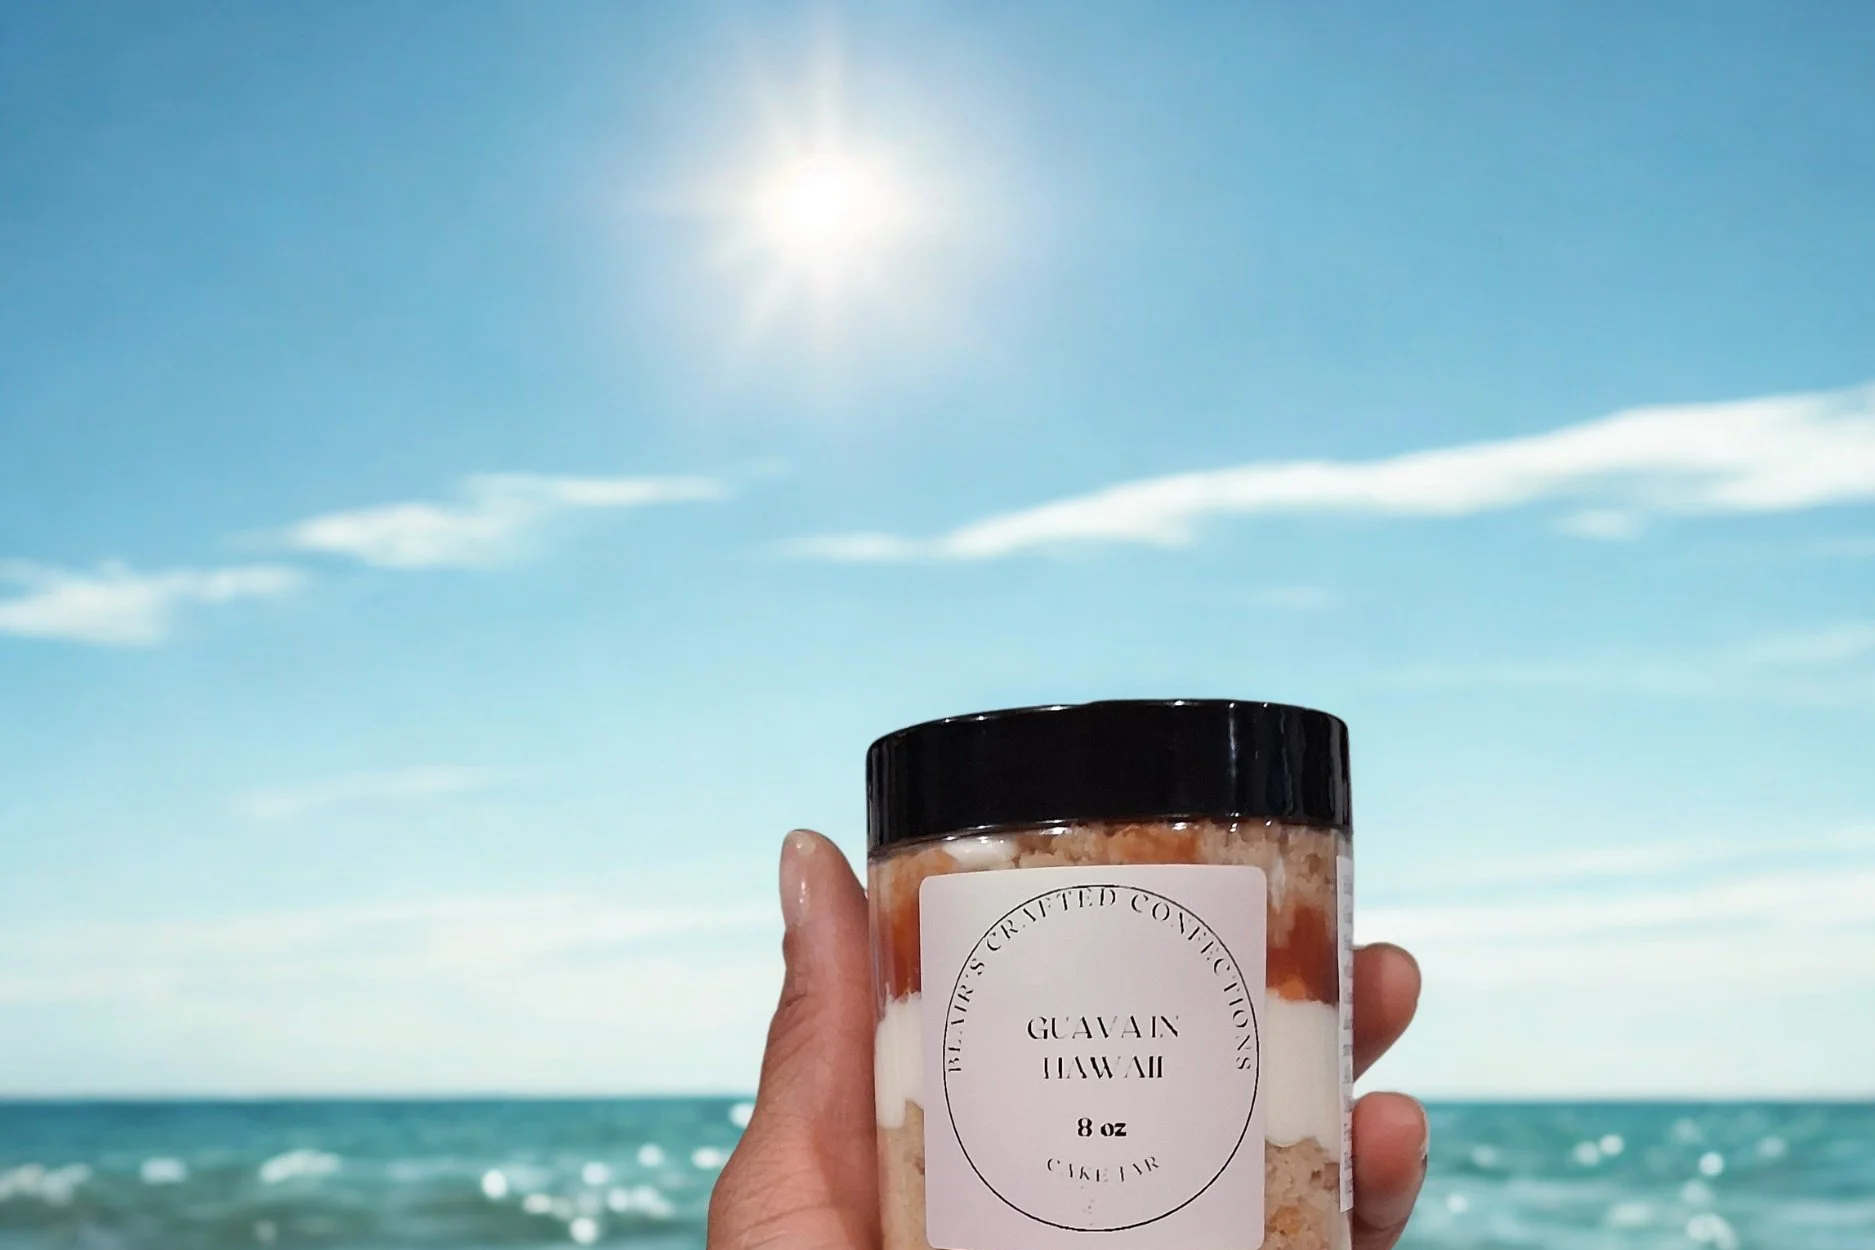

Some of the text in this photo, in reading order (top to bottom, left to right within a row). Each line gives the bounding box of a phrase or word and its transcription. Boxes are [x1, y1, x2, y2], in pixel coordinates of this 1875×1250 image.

[947, 887, 1253, 1073] BLAIR'S CRAFTED CONFECTIONS
[1026, 1014, 1180, 1040] GUAVA IN
[1043, 1055, 1163, 1080] HAWAII
[1076, 1116, 1128, 1138] 8 oz
[1046, 1157, 1110, 1183] CAKE
